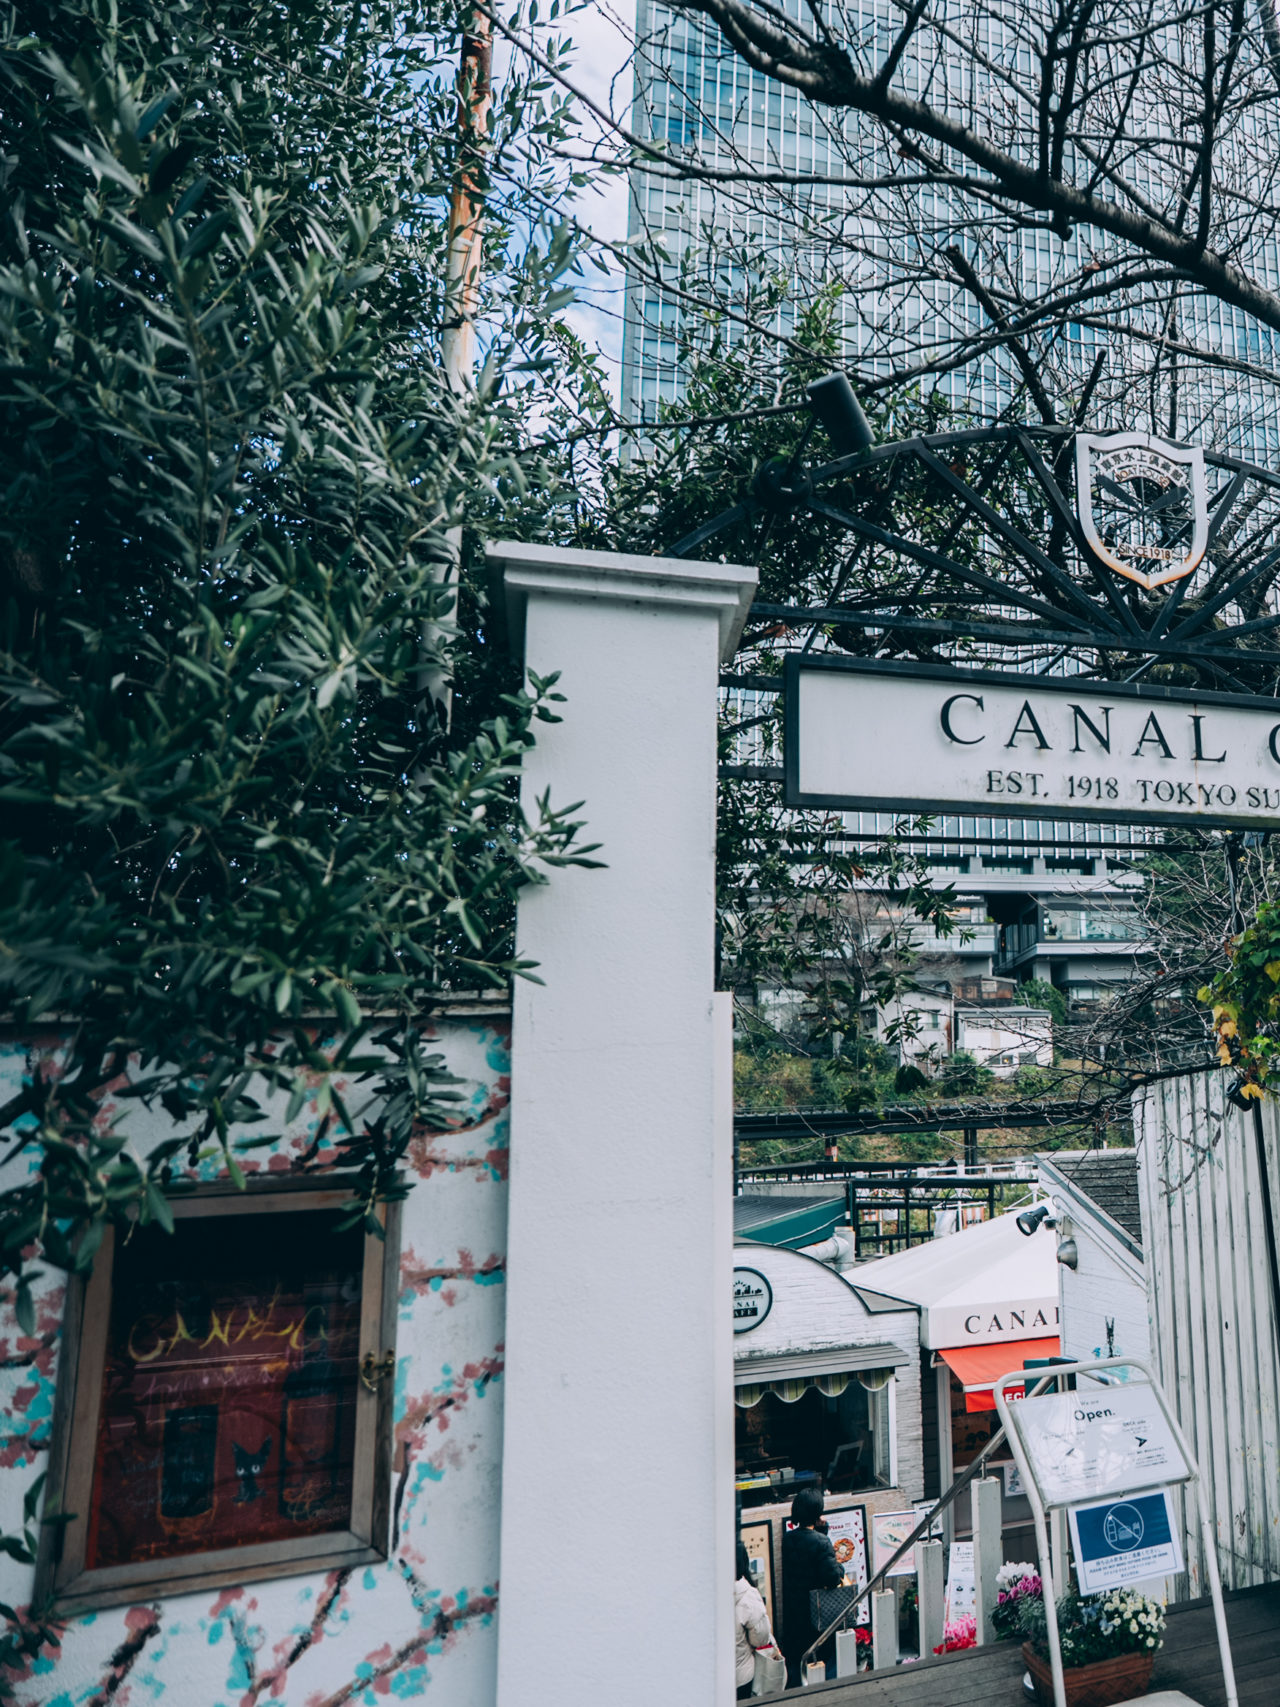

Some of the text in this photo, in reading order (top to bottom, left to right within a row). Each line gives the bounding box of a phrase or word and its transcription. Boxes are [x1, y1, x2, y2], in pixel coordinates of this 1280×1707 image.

[1139, 468, 1170, 488] HOUSE
[1119, 543, 1171, 560] SINCE 1918
[940, 693, 1227, 763] CANAL
[986, 769, 1048, 797] EST.
[1068, 774, 1119, 799] 1918
[1136, 779, 1237, 806] TOKYO
[1074, 1408, 1116, 1423] Open.
